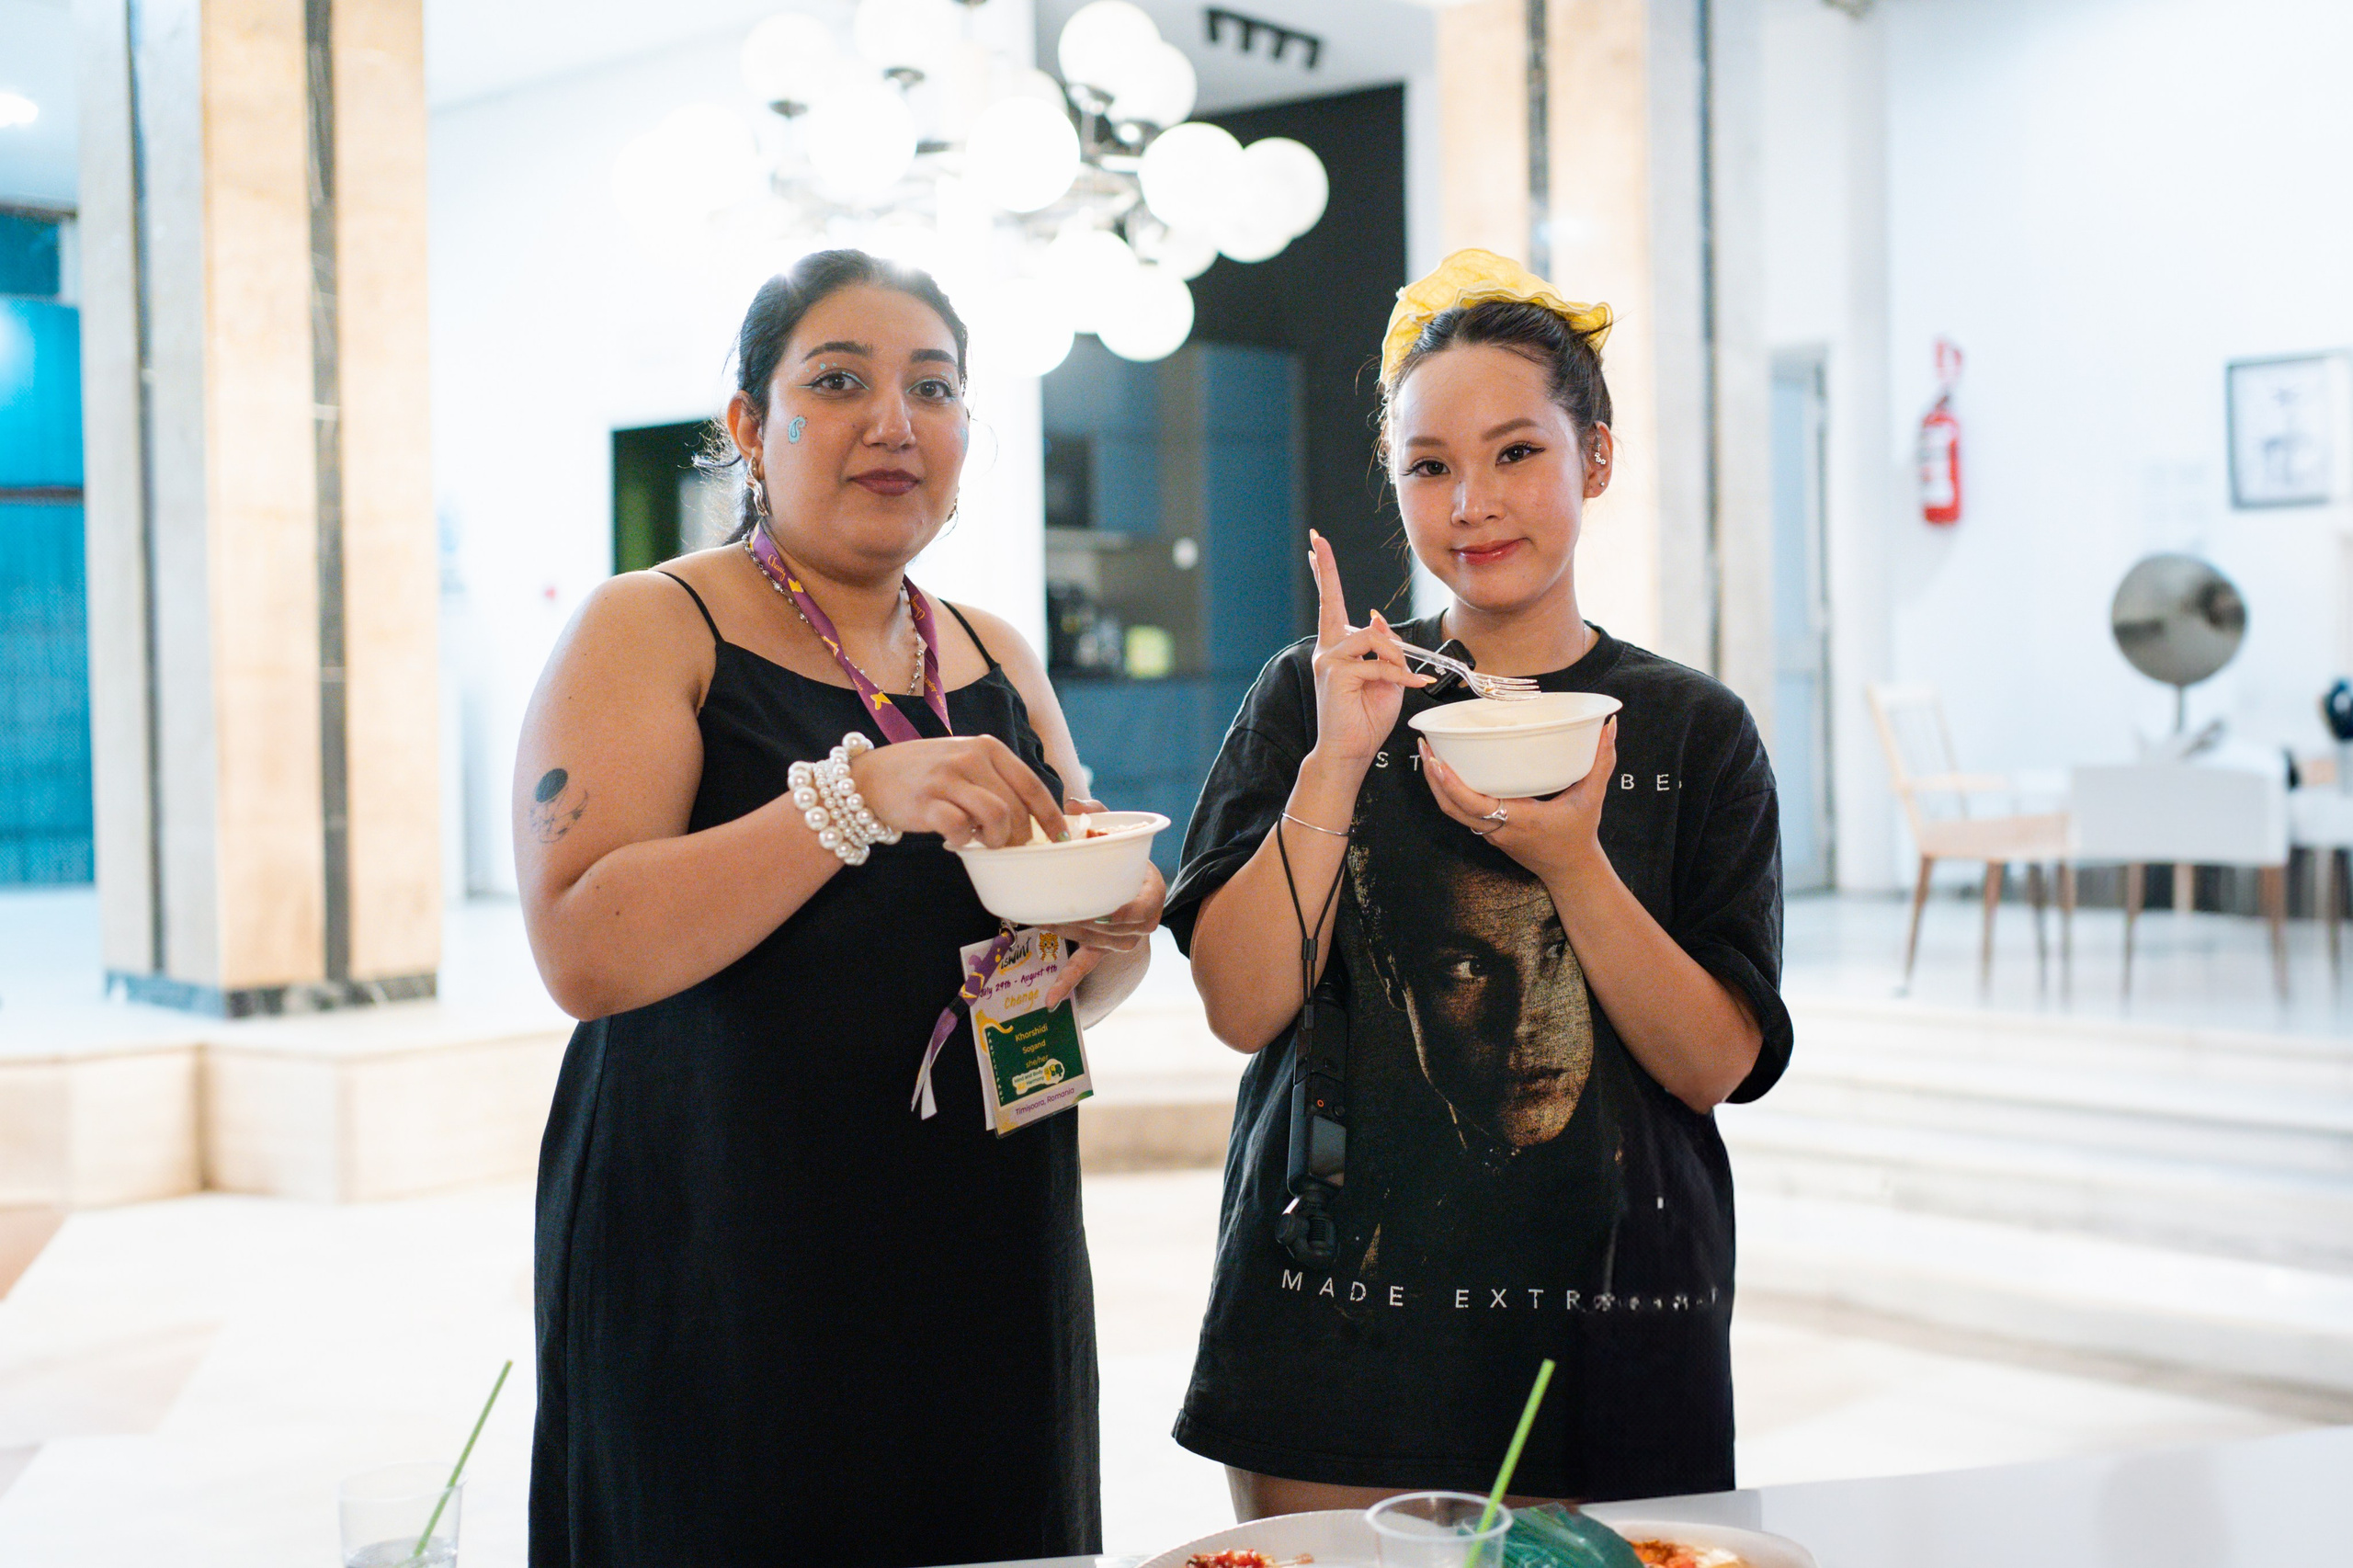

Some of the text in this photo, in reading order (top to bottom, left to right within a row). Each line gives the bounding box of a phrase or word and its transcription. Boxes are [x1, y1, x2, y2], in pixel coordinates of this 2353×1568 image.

[1620, 772, 1682, 792] BE
[995, 979, 1011, 992] 29th
[1021, 970, 1043, 986] August
[1046, 964, 1058, 974] 9th
[1004, 989, 1039, 1011] Change
[1015, 1023, 1048, 1041] Khorshidi
[1022, 1040, 1046, 1054] Sogand
[1026, 1055, 1049, 1069] she/her
[1047, 1087, 1074, 1103] Romania
[1281, 1268, 1404, 1308] MADE
